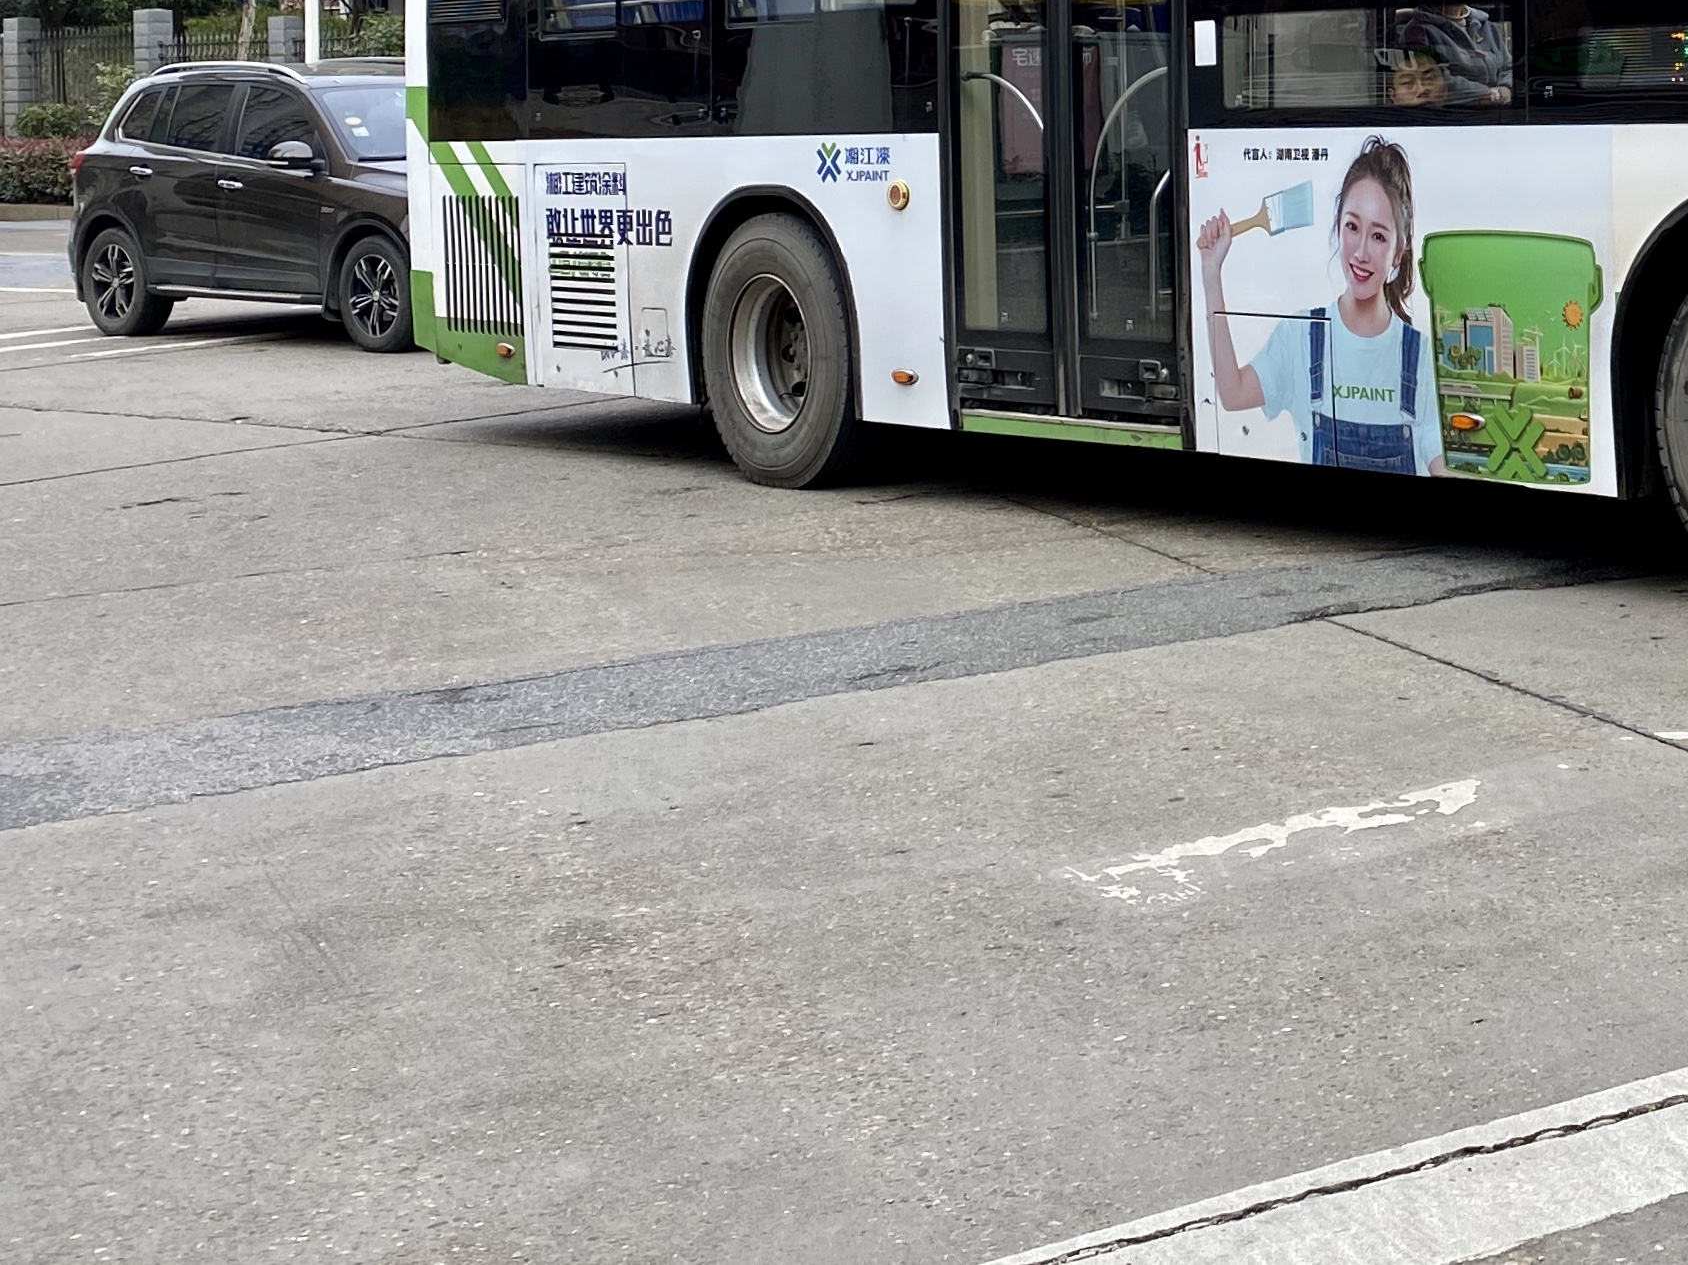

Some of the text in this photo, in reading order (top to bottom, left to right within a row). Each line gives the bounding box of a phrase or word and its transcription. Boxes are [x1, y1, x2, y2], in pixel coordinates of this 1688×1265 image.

[545, 171, 627, 195] 湘江建筑涂料
[846, 170, 890, 182] XJPAINT
[546, 208, 673, 246] 敢让世界更出色
[1333, 384, 1396, 403] XJPAINT
